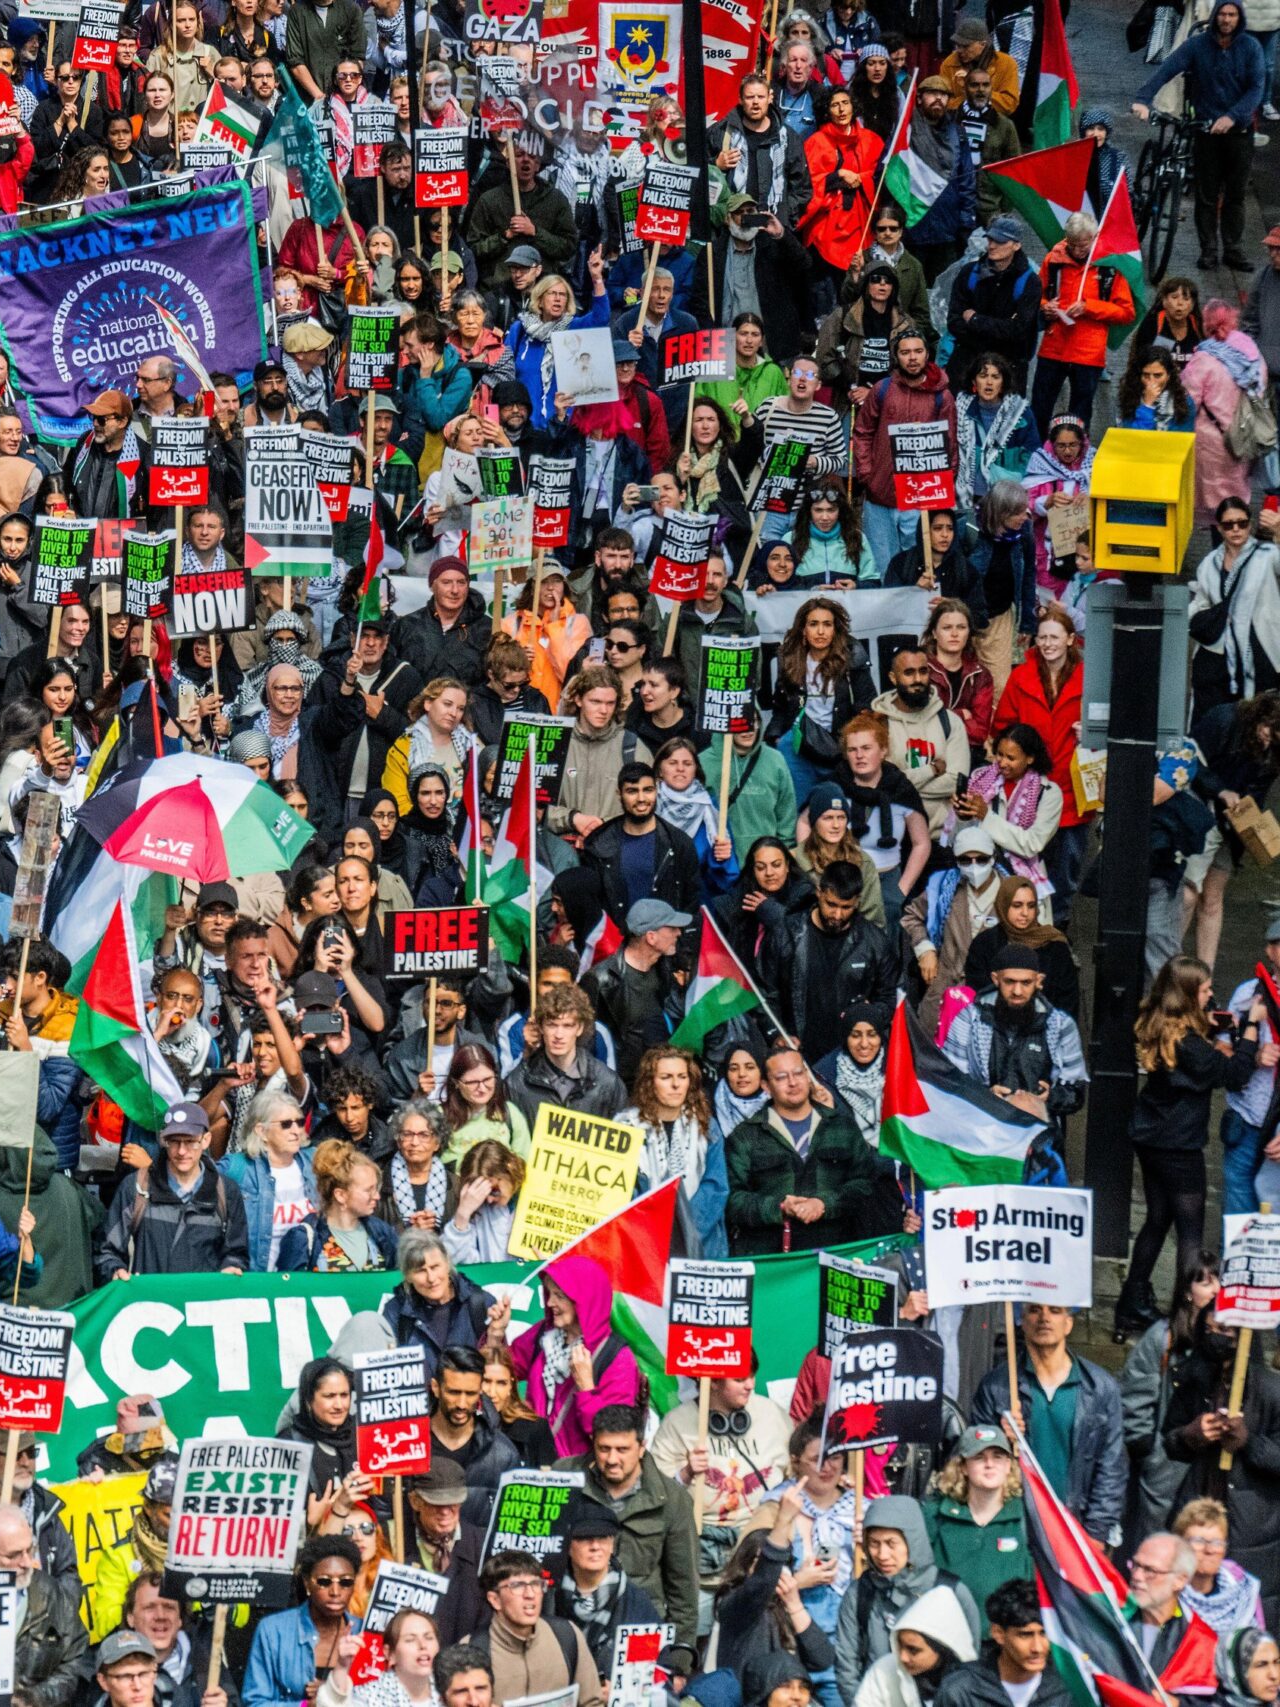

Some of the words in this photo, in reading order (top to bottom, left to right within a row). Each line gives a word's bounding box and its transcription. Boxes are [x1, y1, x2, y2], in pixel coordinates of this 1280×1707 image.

[84, 9, 120, 25] FREEDOM
[79, 25, 119, 41] PALESTINE
[465, 14, 540, 42] GAZA
[83, 40, 110, 53] الحرية
[704, 49, 731, 59] 1886
[78, 52, 112, 65] لفلسطين
[421, 138, 463, 153] FREEDOM
[418, 155, 465, 172] PALESTINE
[648, 171, 693, 192] FREEDOM
[641, 189, 691, 210] PALESTINE
[164, 199, 239, 242] NEU
[52, 288, 78, 383] SUPPORTING
[75, 269, 103, 293] ALL
[101, 259, 186, 287] EDUCATION
[182, 280, 216, 350] WORKERS
[99, 312, 162, 337] national
[353, 318, 377, 330] FROM
[378, 317, 395, 330] THE
[351, 328, 376, 342] RIVER
[378, 328, 390, 342] TO
[351, 340, 367, 353] THE
[368, 341, 386, 353] SEA
[664, 329, 726, 368] FREE
[349, 352, 395, 365] PALESTINE
[349, 364, 371, 376] WILL
[371, 366, 385, 377] BE
[664, 360, 726, 383] PALESTINE
[157, 429, 205, 445] FREEDOM
[895, 434, 945, 451] FREEDOM
[153, 450, 206, 466] PALESTINE
[895, 454, 949, 472] PALESTINE
[161, 470, 197, 486] الحرية
[905, 476, 941, 492] الحرية
[156, 484, 202, 499] لفلسطين
[904, 488, 948, 504] لفلسطين
[259, 488, 323, 522] NOW!
[42, 527, 69, 542] FROM
[71, 529, 90, 543] THE
[666, 522, 711, 542] FREEDOM
[39, 540, 69, 555] RIVER
[70, 542, 83, 555] TO
[660, 542, 710, 563] PALESTINE
[38, 552, 58, 567] THE
[59, 554, 77, 568] SEA
[37, 564, 87, 580] PALESTINE
[35, 577, 59, 592] WILL
[61, 580, 73, 592] BE
[174, 571, 245, 595] CEASEFIRE
[173, 587, 246, 634] NOW
[140, 848, 190, 867] PALESTINE
[393, 909, 478, 953] FREE
[393, 949, 477, 972] PALESTINE
[547, 1111, 632, 1154] WANTED
[532, 1148, 628, 1193] ITHACA
[551, 1180, 605, 1202] ENERGY
[992, 1203, 1084, 1238] Arming
[965, 1235, 1052, 1265] Israel
[677, 1276, 748, 1299] FREEDOM
[672, 1303, 749, 1326] PALESTINE
[362, 1363, 425, 1393] FREEDOM
[360, 1393, 429, 1423] PALESTINE
[188, 1445, 222, 1469] FREE
[226, 1446, 300, 1470] PALESTINE
[184, 1472, 298, 1494] EXIST!
[181, 1496, 292, 1517] RESIST!
[174, 1515, 291, 1560] RETURN!
